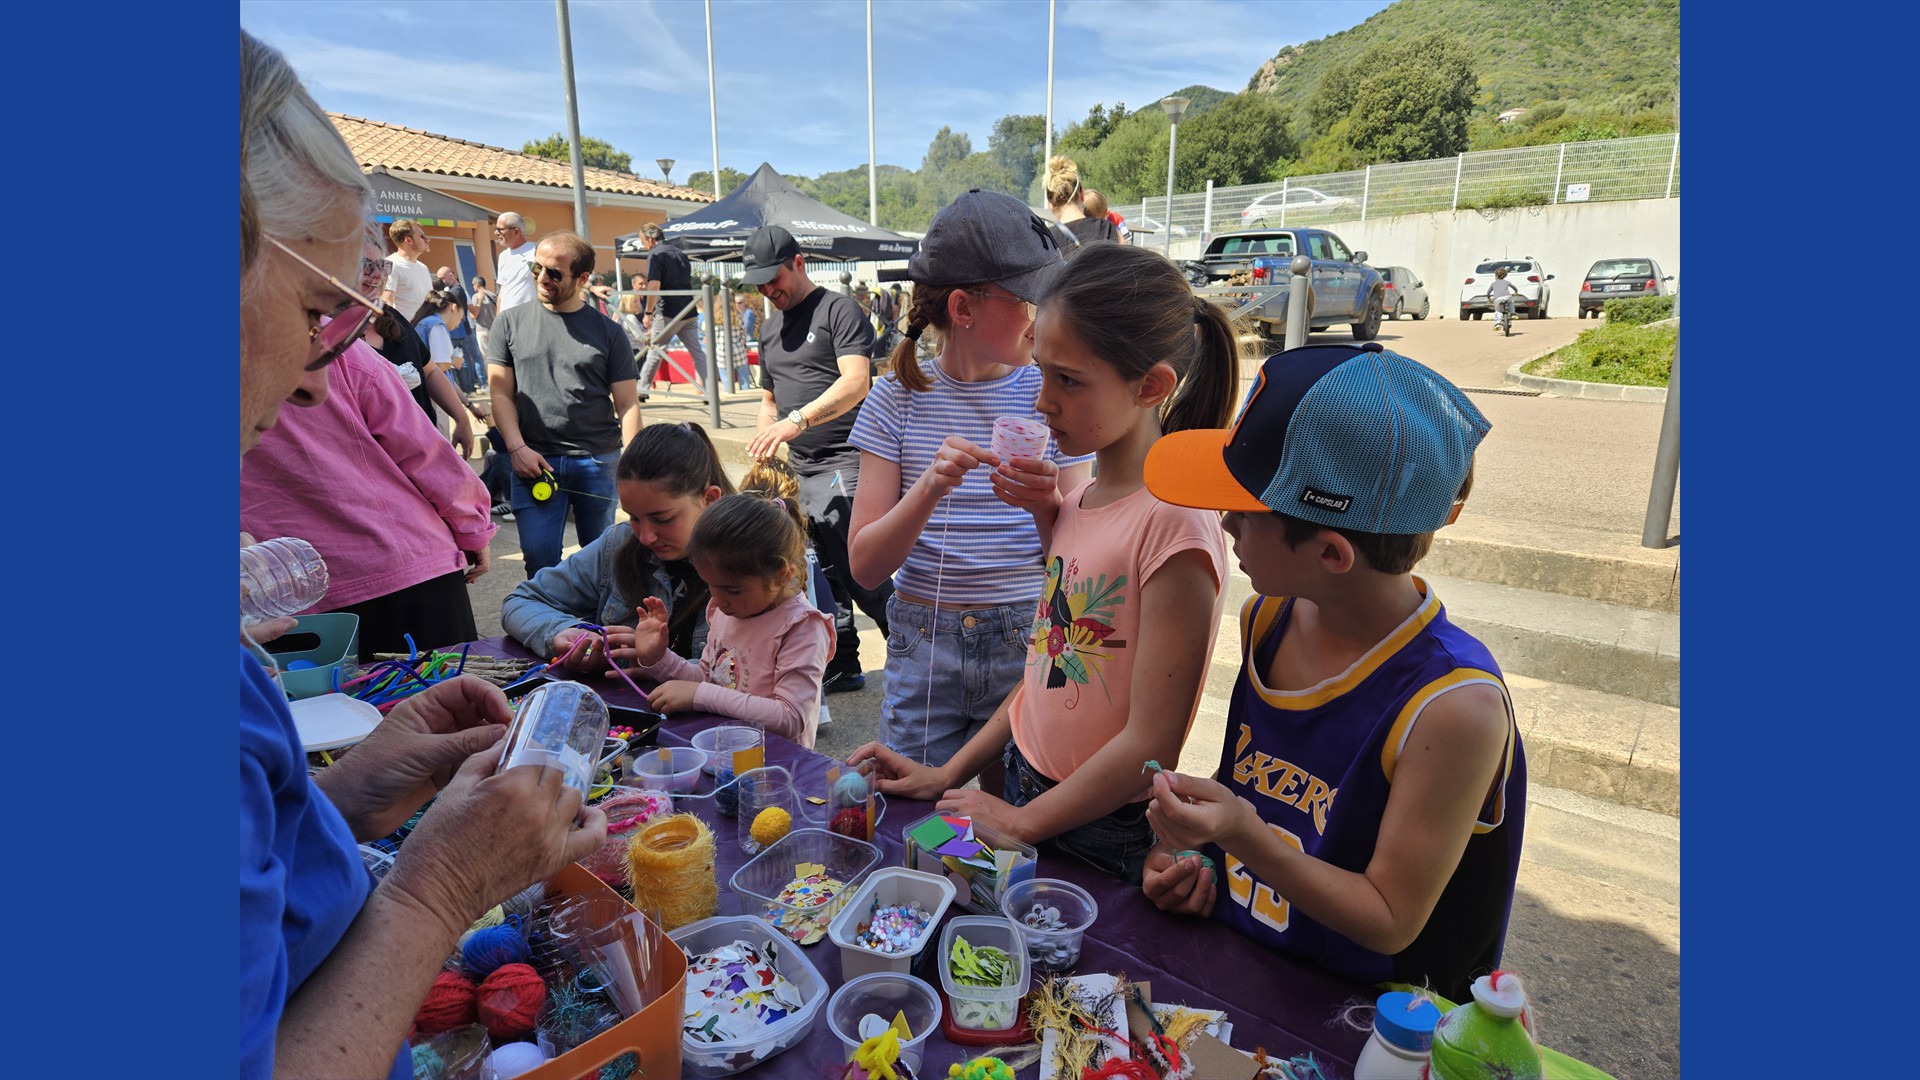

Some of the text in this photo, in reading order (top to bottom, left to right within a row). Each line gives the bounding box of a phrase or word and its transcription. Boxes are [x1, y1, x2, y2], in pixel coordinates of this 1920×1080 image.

[380, 190, 423, 202] ANNEXE
[375, 203, 424, 215] CUMUNA
[791, 220, 868, 233] Sifam.fr
